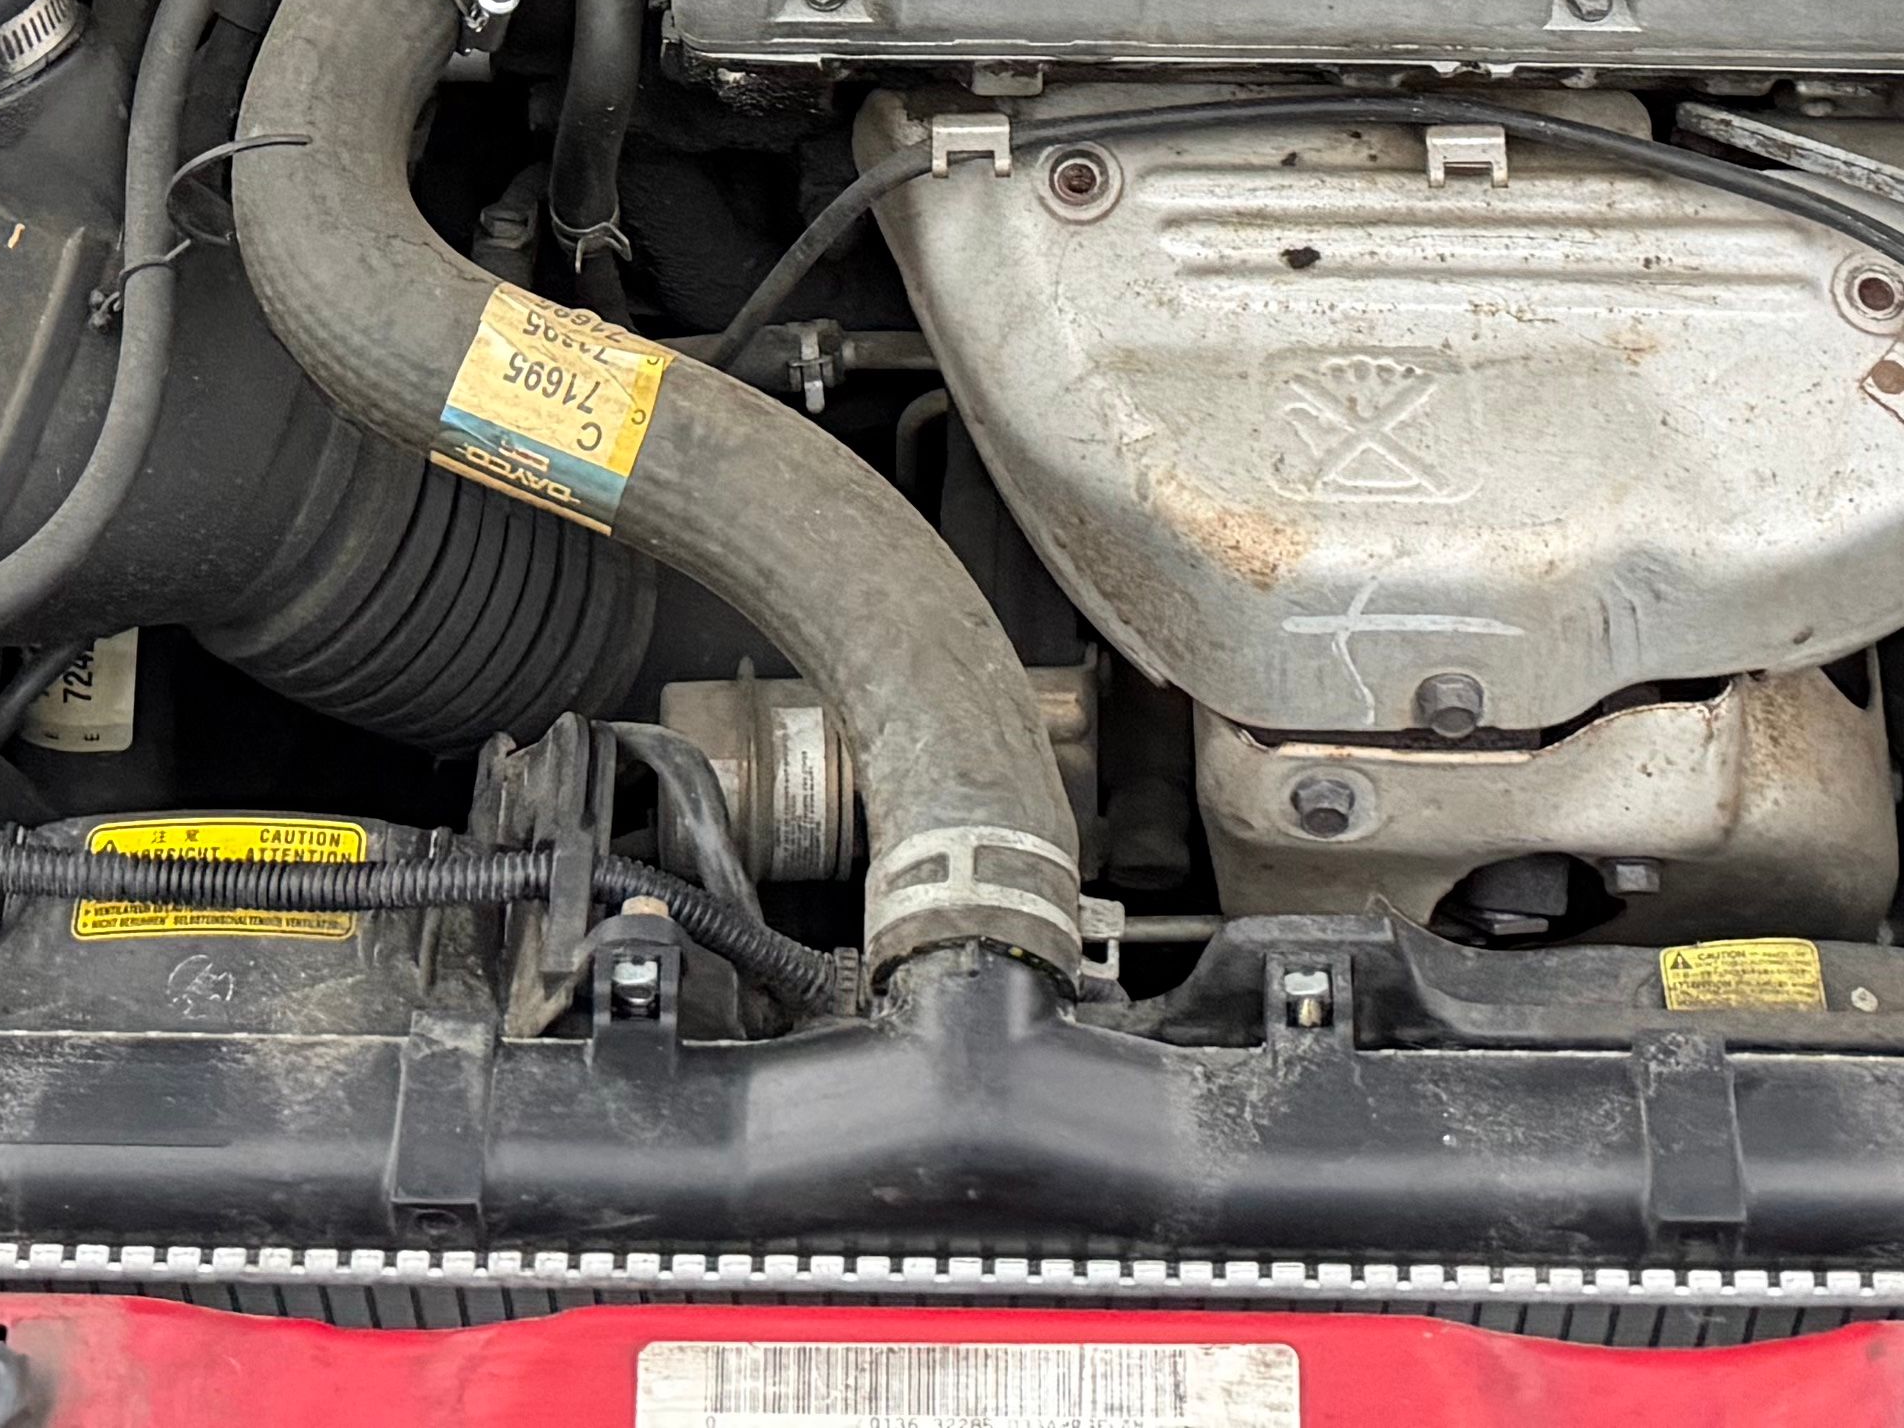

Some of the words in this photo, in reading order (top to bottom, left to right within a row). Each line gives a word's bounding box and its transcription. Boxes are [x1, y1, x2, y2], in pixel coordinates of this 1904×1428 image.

[502, 351, 602, 415] 71695
[576, 421, 603, 453] C
[464, 446, 574, 503] DAYCO
[258, 827, 343, 848] CAUTION
[1697, 949, 1747, 961] CAUTION
